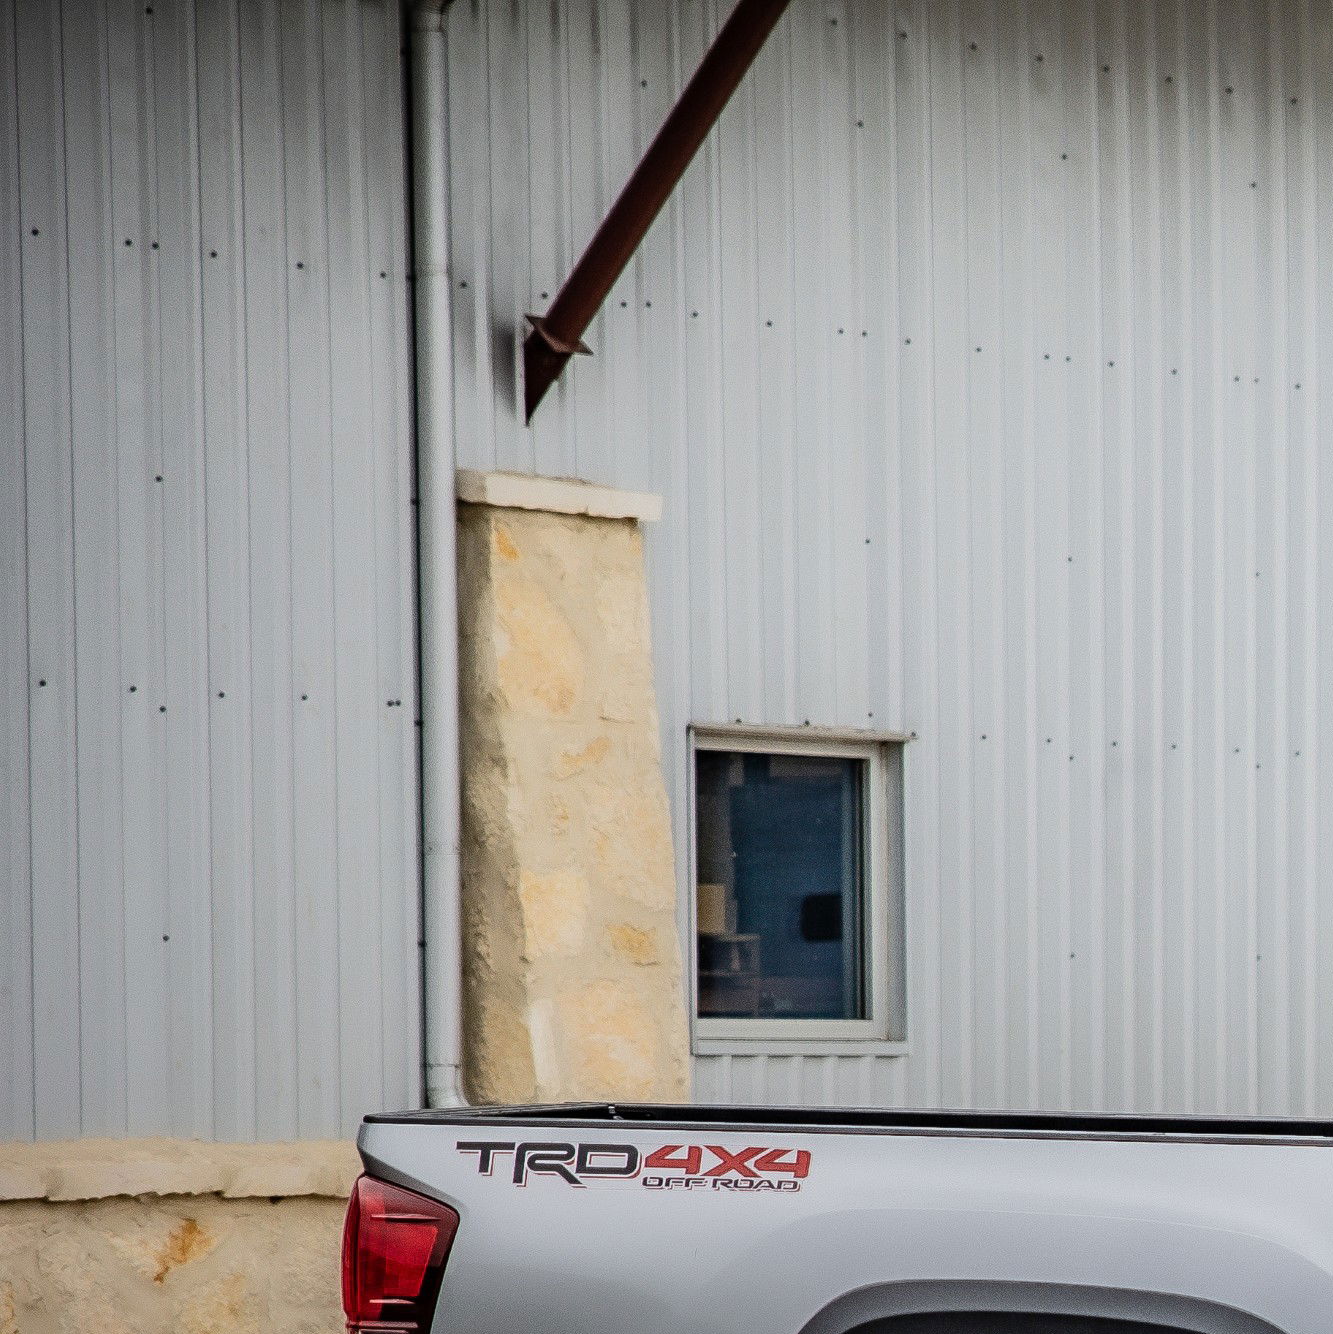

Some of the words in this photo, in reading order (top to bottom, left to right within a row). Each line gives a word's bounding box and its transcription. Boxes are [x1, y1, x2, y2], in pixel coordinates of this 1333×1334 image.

[456, 1141, 643, 1187] TRD
[642, 1176, 706, 1190] OFF
[710, 1178, 802, 1192] ROAD
